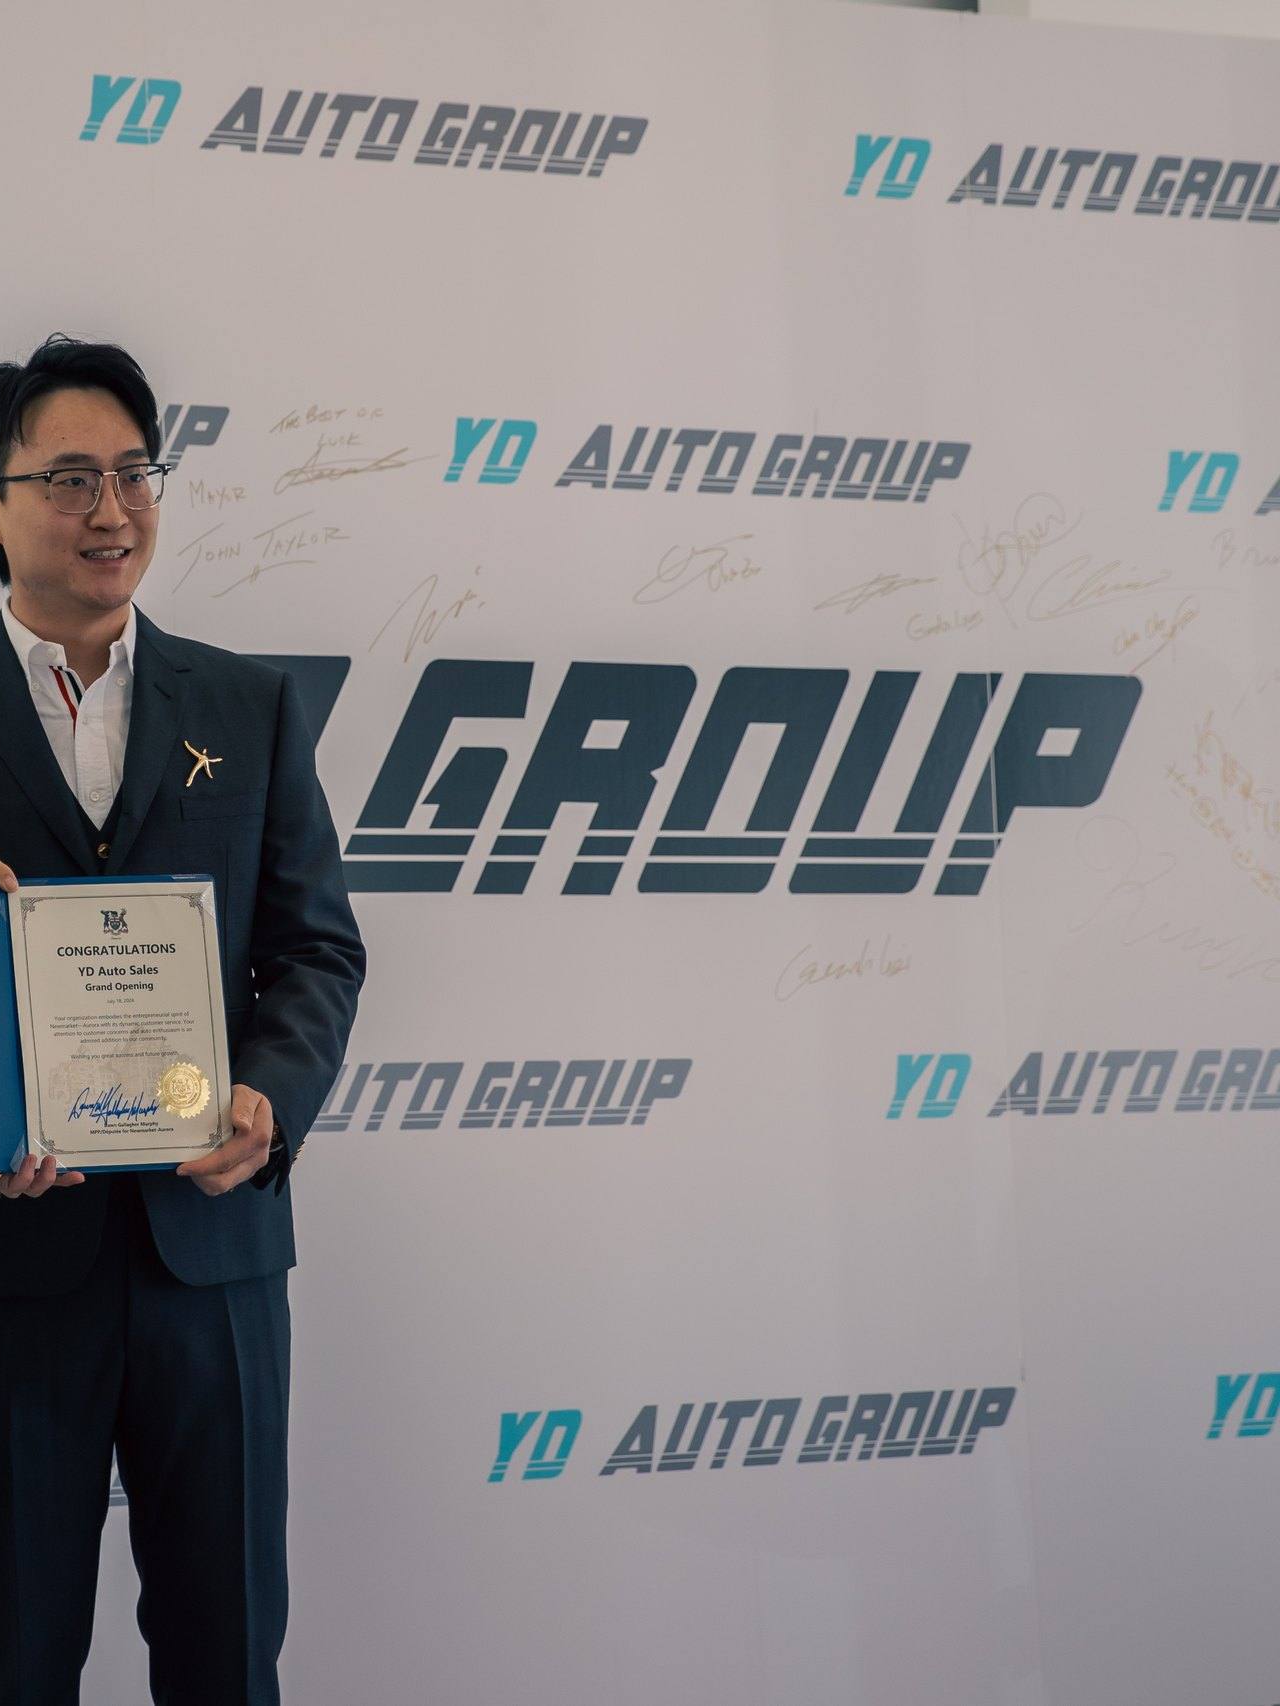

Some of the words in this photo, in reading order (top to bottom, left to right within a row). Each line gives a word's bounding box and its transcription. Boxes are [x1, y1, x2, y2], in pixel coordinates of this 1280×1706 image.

[79, 74, 182, 145] YD
[199, 86, 419, 162] AUTO
[413, 101, 649, 178] GROUP
[844, 134, 932, 200] YD
[947, 143, 1139, 213] AUTO
[1133, 155, 1280, 224] GROU
[443, 416, 538, 485] YD
[554, 424, 757, 495] AUTO
[751, 433, 972, 504] GROUP
[1157, 450, 1240, 513] YD
[252, 509, 352, 560] TAYLOR
[343, 658, 1143, 896] GROUP
[57, 943, 176, 957] CONGRATULATIONS
[78, 966, 95, 977] YD
[98, 966, 126, 976] Auto
[129, 964, 159, 975] Sales
[85, 982, 113, 991] Grand
[115, 981, 154, 992] Opening
[311, 1061, 465, 1133] UTO
[458, 1058, 693, 1129] GROUP
[885, 1053, 972, 1120] YD
[986, 1049, 1179, 1118] AUTO
[487, 1409, 583, 1483] YD
[598, 1397, 802, 1477] AUTO
[796, 1386, 1017, 1464] GROUP
